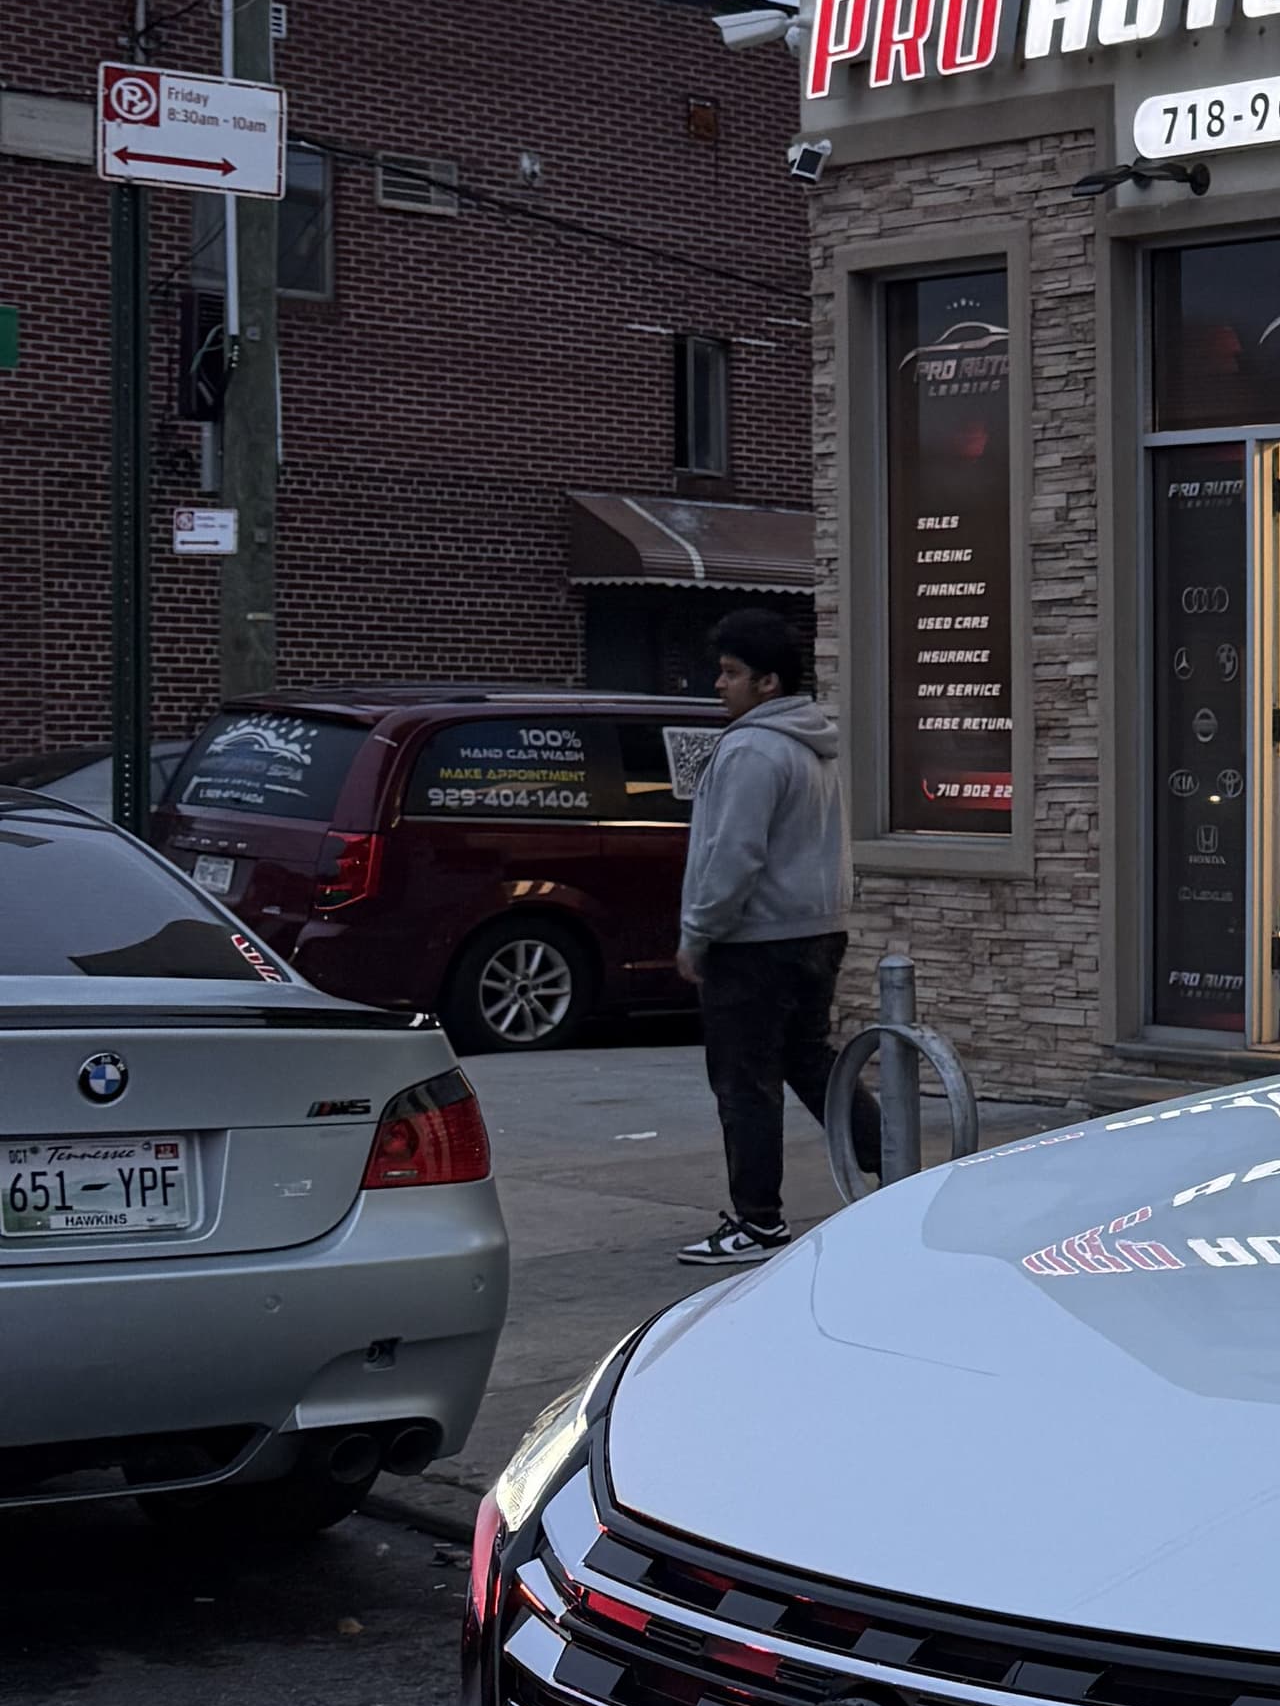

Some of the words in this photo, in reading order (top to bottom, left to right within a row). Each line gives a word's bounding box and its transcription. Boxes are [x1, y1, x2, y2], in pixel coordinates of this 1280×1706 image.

[167, 87, 209, 107] Friday
[167, 108, 219, 127] 8:30am
[232, 116, 267, 133] 10am
[914, 360, 957, 383] PRO
[1168, 483, 1200, 497] PRO
[917, 516, 959, 530] SALES
[917, 549, 973, 563] LEASING
[917, 583, 986, 597] FINANCING
[917, 616, 952, 629] USED
[954, 616, 989, 629] CARS
[917, 650, 990, 663] INSURANCE
[918, 684, 944, 696] DMV
[946, 684, 1001, 696] SERVICE
[918, 717, 960, 730] LEASE
[519, 729, 582, 748] 100%
[461, 748, 503, 759] HAND
[506, 749, 538, 760] CAR
[541, 750, 585, 762] WASH
[440, 768, 482, 779] MAKE
[486, 769, 586, 782] APPOINTMENT
[937, 783, 960, 797] 718
[962, 784, 991, 798] 902
[428, 788, 589, 808] 929-404-1404
[1169, 971, 1200, 986] PRO
[47, 1145, 136, 1165] Tennessee
[10, 1170, 73, 1212] 651
[118, 1166, 178, 1207] YPF
[65, 1214, 127, 1226] HAWKINS
